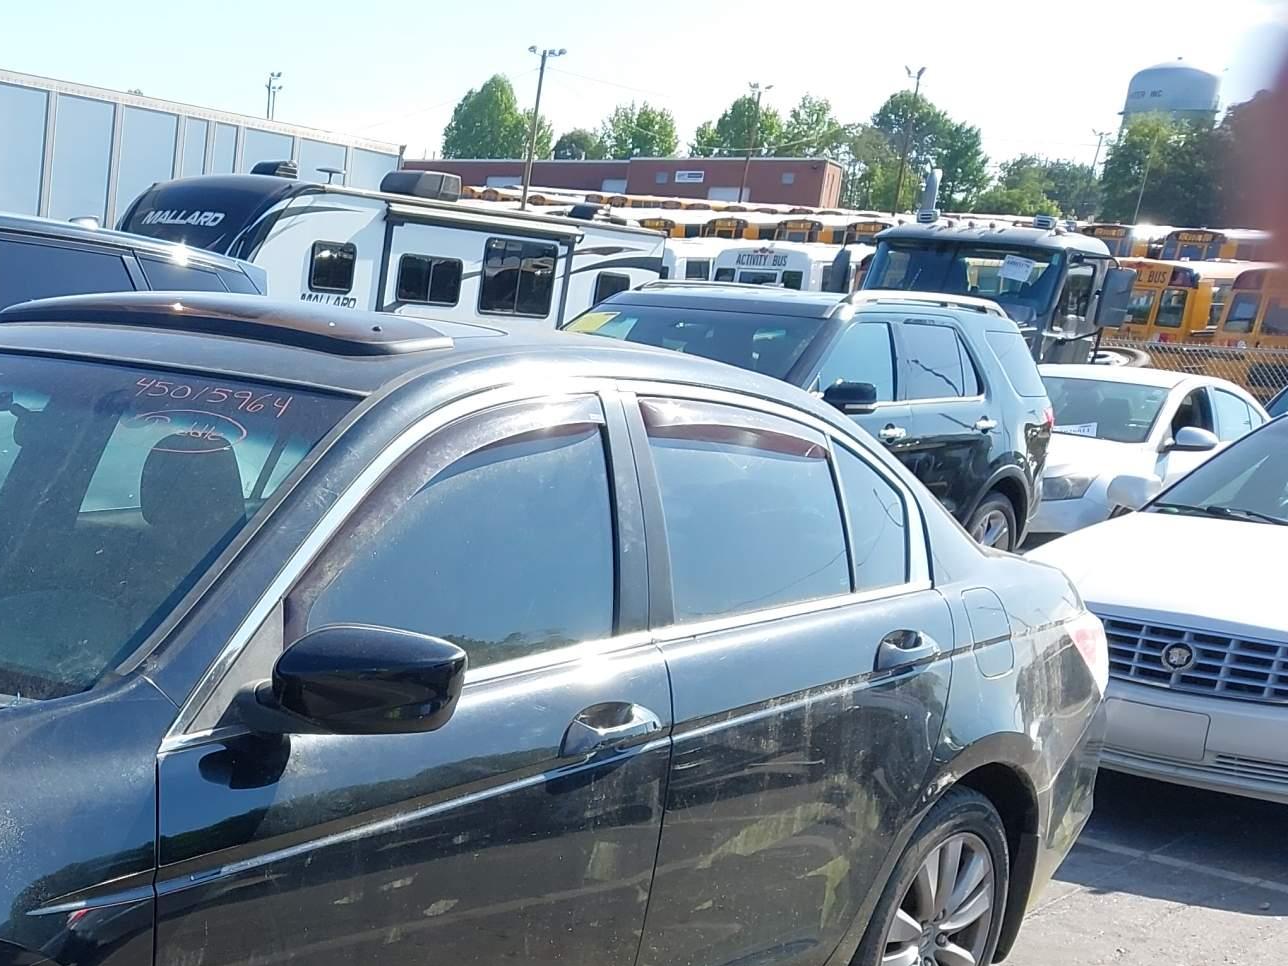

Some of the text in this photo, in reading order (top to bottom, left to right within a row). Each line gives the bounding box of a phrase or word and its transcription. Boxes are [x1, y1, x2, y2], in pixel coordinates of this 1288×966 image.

[142, 210, 225, 227] MALLARD
[736, 254, 788, 267] ACTIVITY BUS
[1147, 270, 1168, 284] BUS
[135, 377, 293, 418] 45015964
